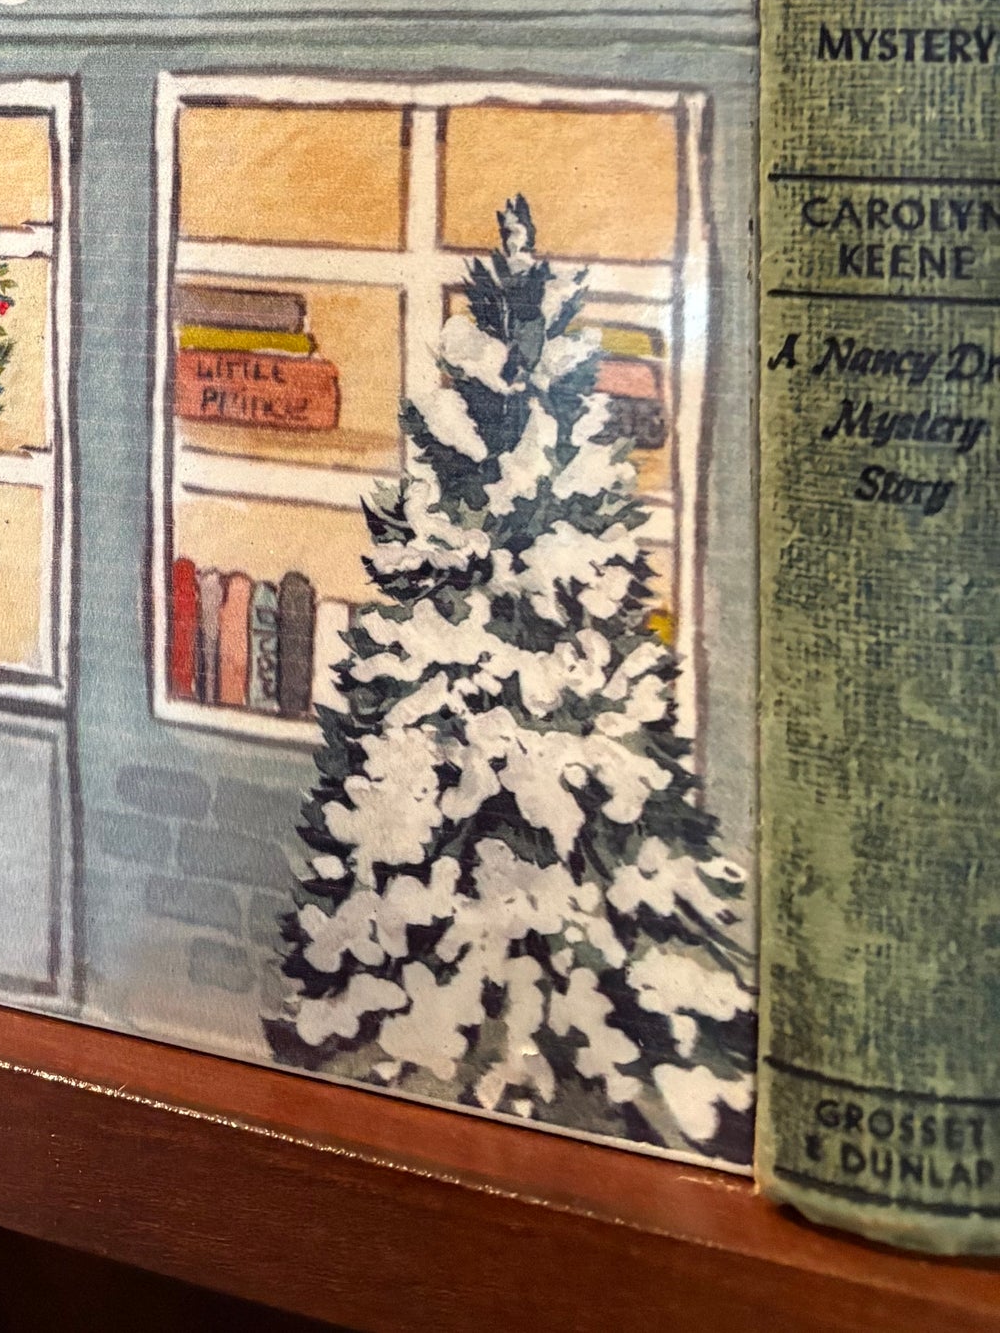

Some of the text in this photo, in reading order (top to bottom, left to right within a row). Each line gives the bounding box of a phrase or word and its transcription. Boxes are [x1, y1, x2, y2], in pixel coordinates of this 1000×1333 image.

[817, 23, 996, 64] MYSTERY
[801, 197, 1000, 232] CAROLYN
[837, 243, 977, 280] KEENE
[767, 333, 799, 371] A
[812, 336, 940, 387] Nancy
[821, 398, 990, 454] Mystery
[854, 465, 956, 516] Story
[815, 1099, 987, 1152] GROSSET
[841, 1142, 996, 1188] DUNLAP
